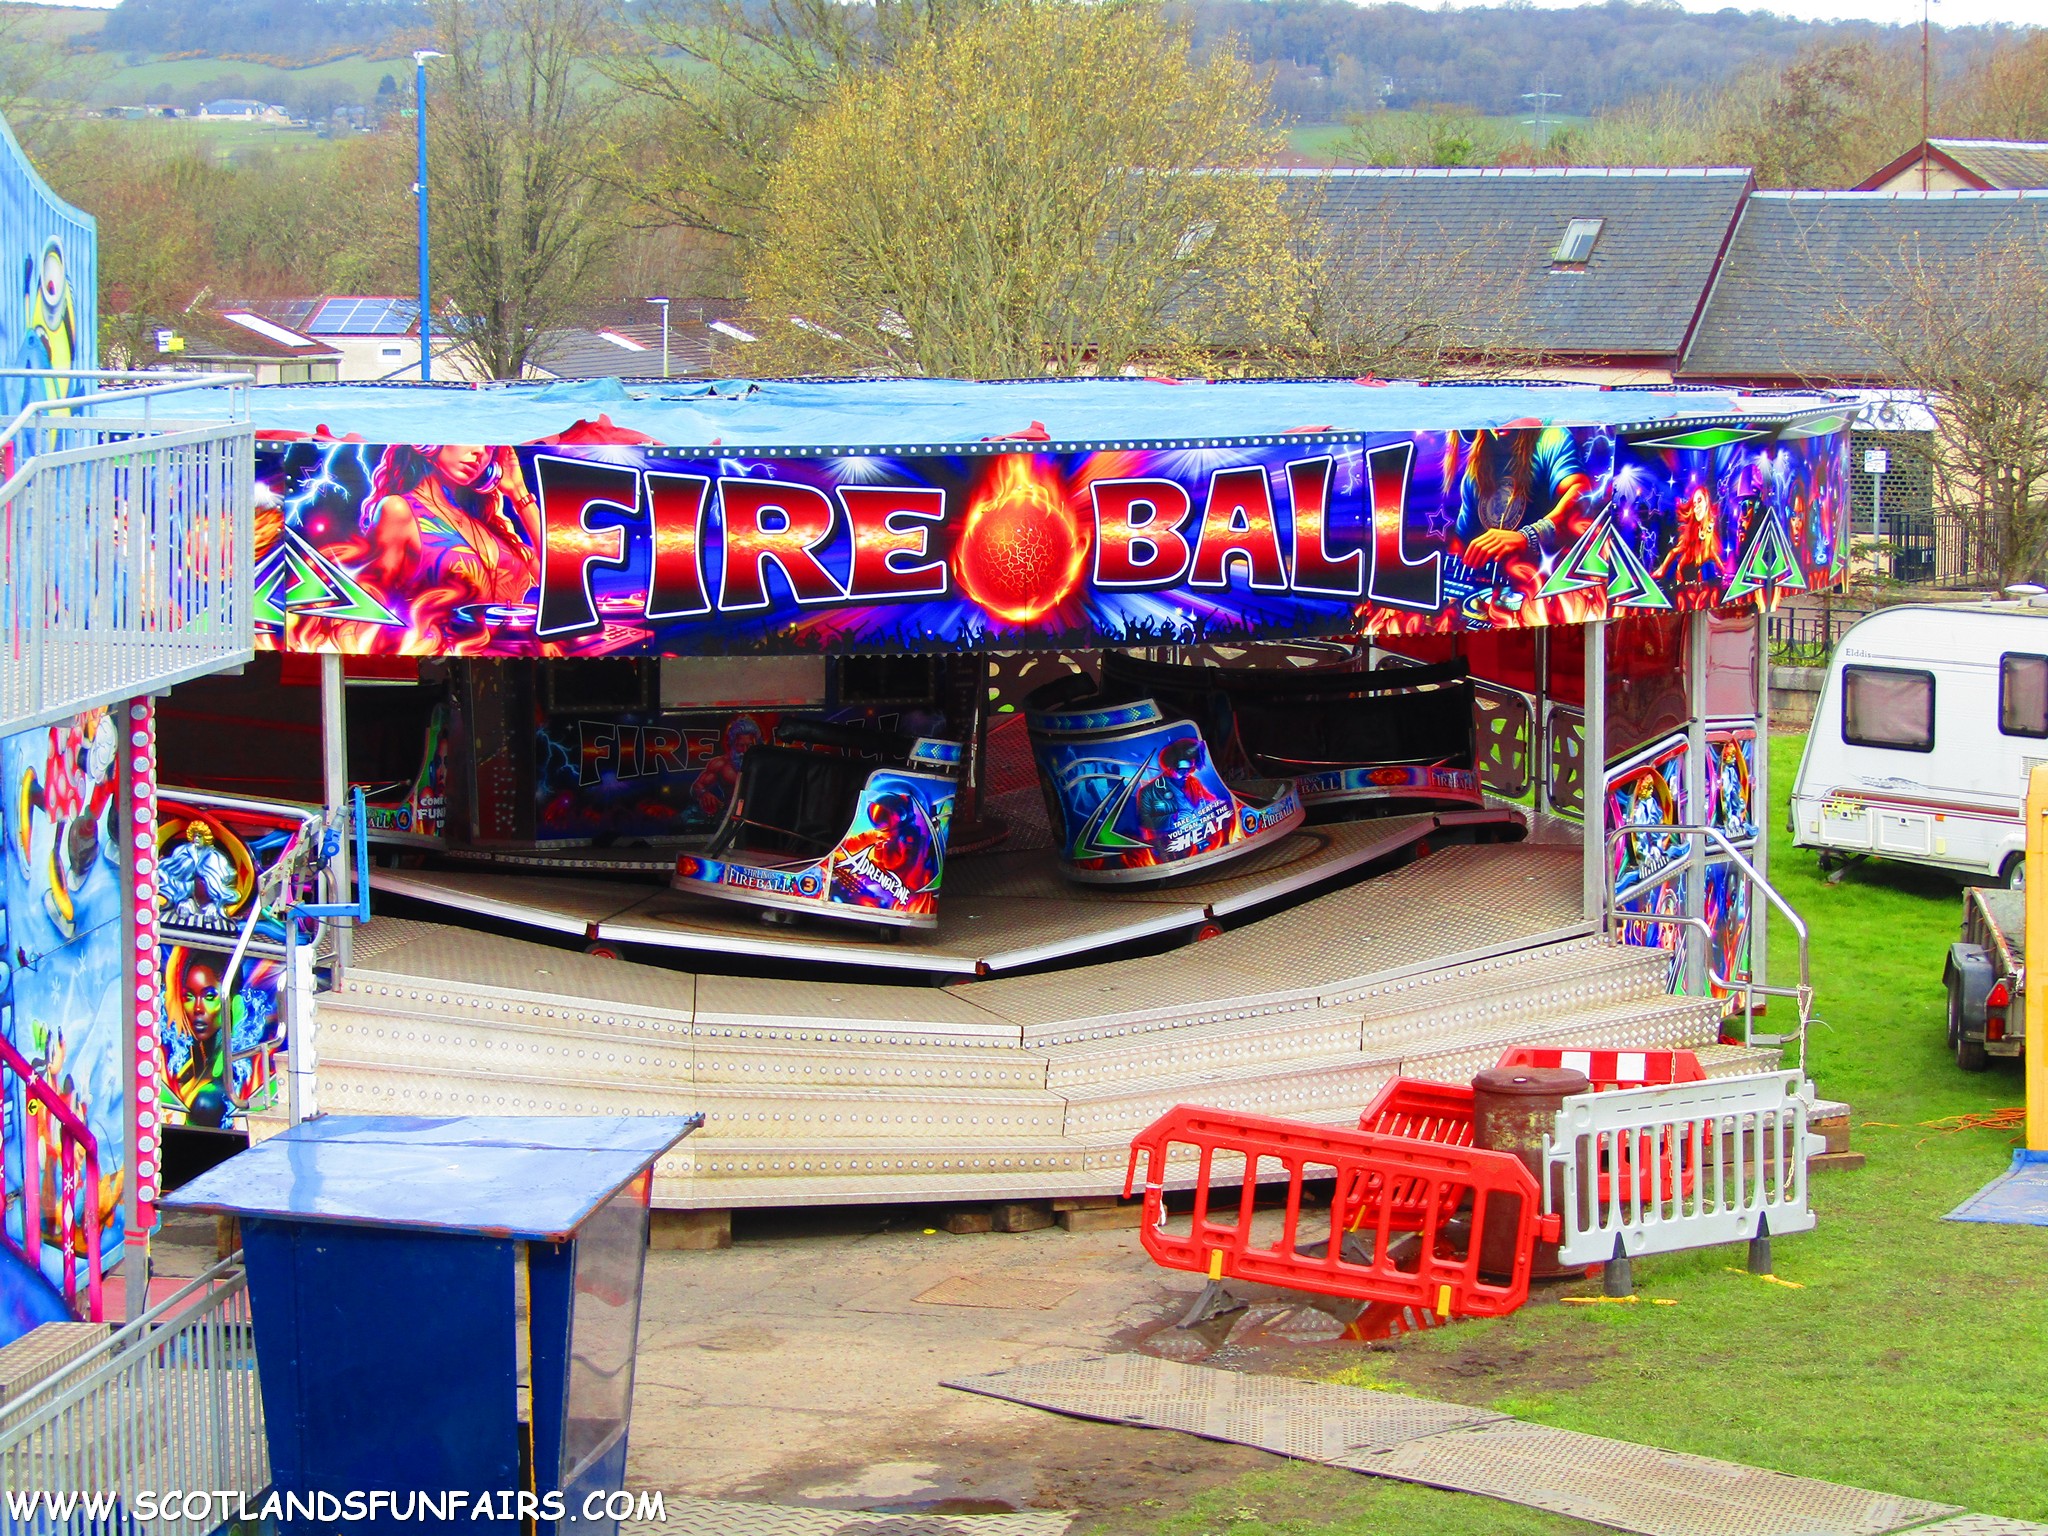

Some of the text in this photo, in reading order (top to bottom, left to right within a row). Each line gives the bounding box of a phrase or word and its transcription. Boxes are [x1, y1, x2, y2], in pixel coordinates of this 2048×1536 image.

[534, 440, 1441, 636] FIRE BALL
[1845, 648, 1872, 658] Elddis
[578, 719, 721, 787] FIRE
[1173, 816, 1190, 829] TAKE
[1200, 812, 1216, 824] TAKE
[1215, 804, 1229, 816] THE
[1246, 816, 1256, 829] 2
[1167, 810, 1234, 852] HEAT
[728, 867, 790, 893] FIREBALL
[803, 879, 815, 892] 3
[834, 845, 910, 905] ADRENALINE
